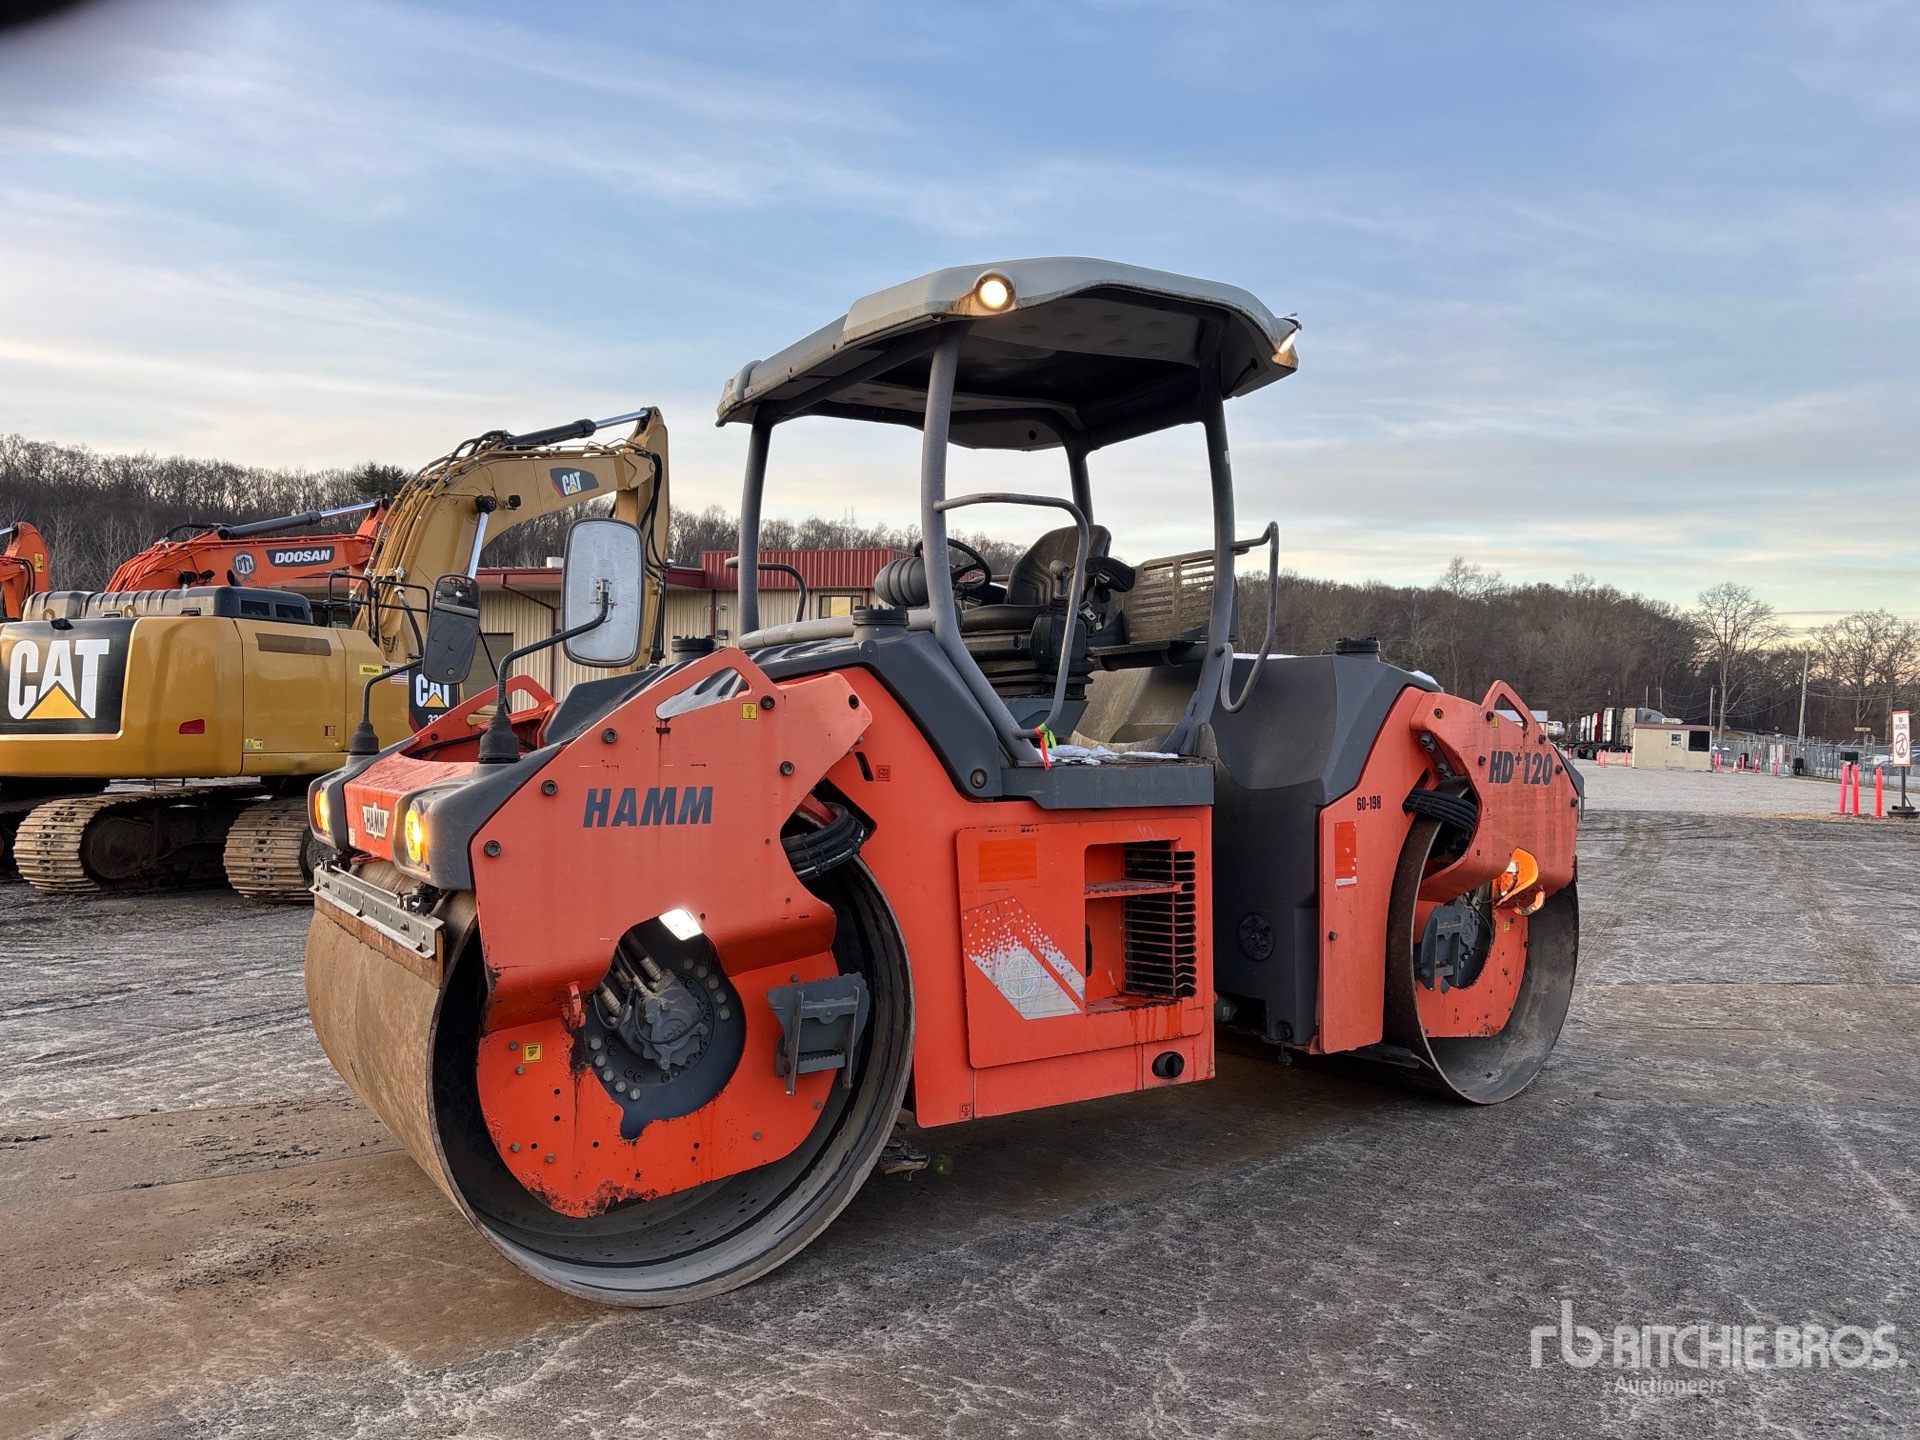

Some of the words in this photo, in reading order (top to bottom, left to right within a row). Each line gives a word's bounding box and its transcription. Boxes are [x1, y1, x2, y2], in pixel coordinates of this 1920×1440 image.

[561, 471, 582, 496] CAT
[274, 549, 331, 564] DOOSAN
[8, 638, 110, 720] CAT
[582, 786, 713, 828] HAMM
[365, 808, 386, 834] HAMM
